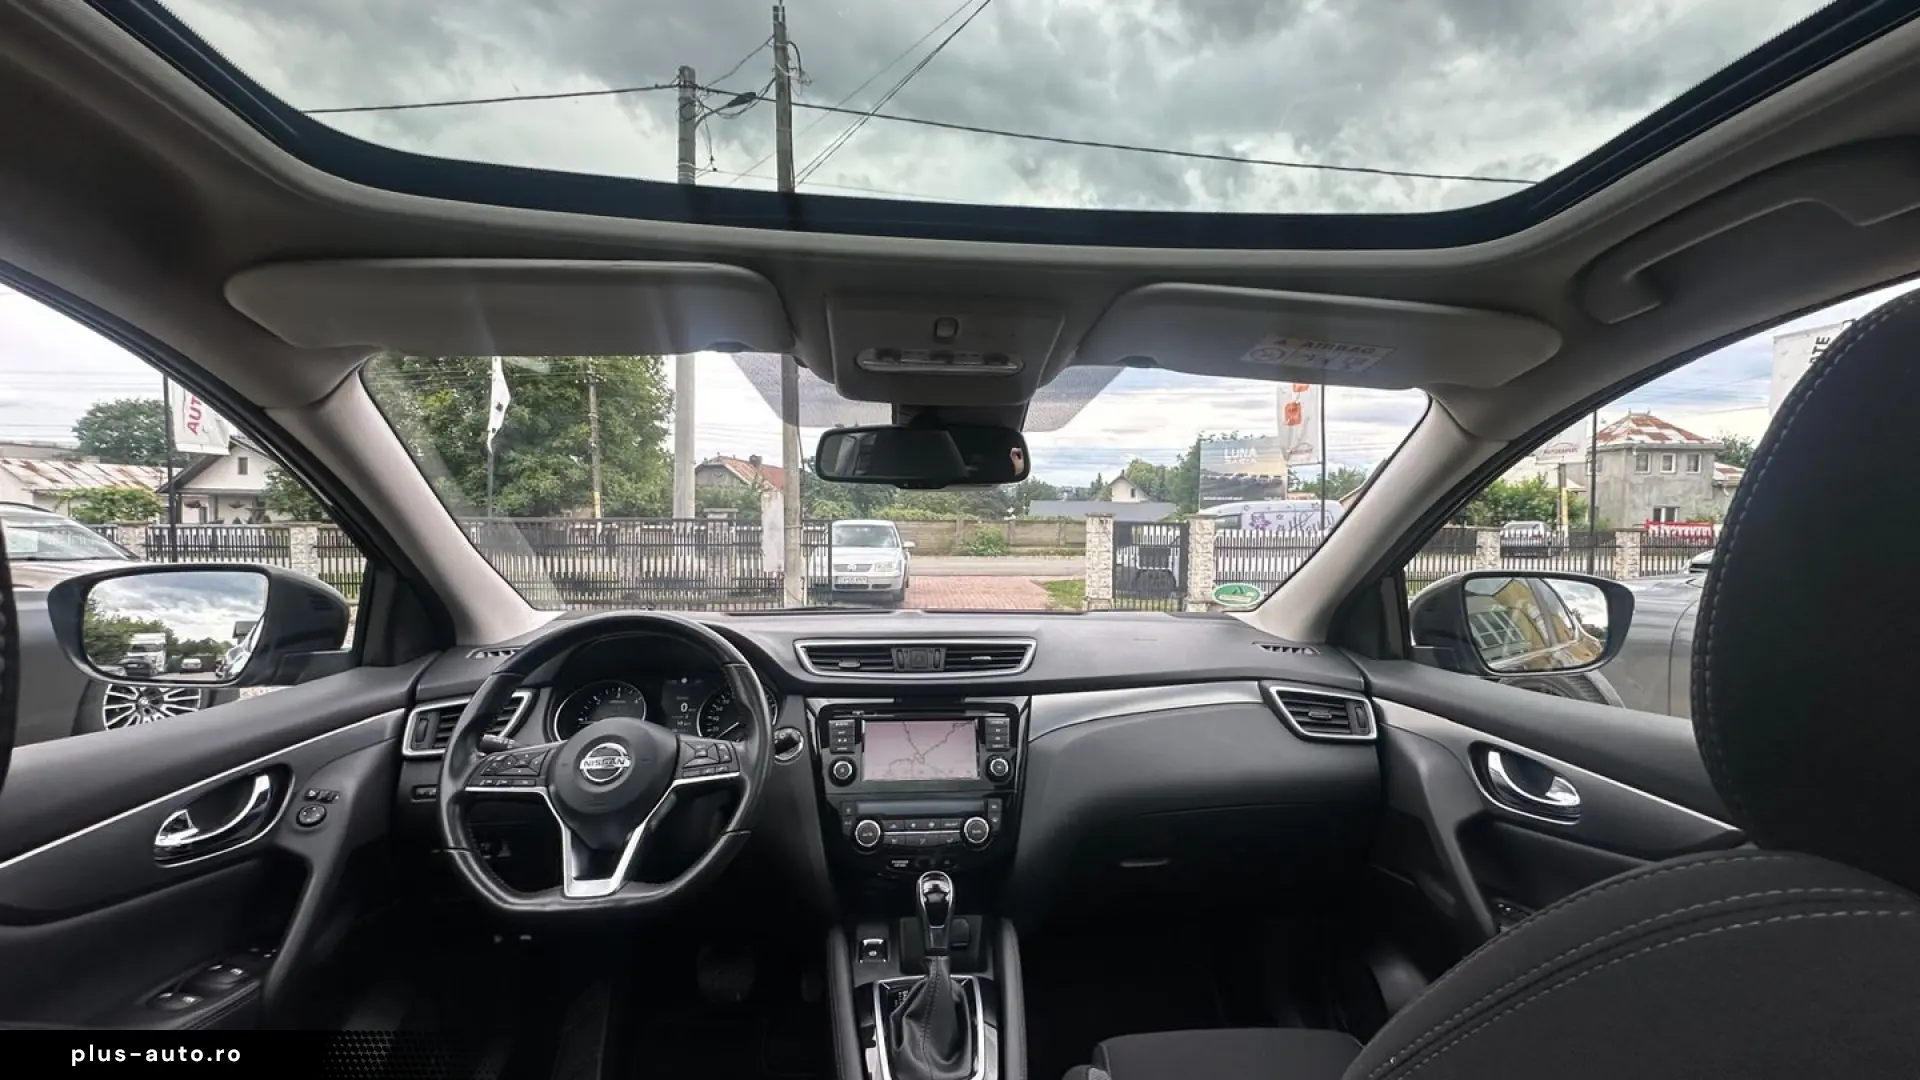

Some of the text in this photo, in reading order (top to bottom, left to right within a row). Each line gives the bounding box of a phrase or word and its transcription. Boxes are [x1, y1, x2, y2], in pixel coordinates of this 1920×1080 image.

[1300, 340, 1377, 355] AIRBAG
[1223, 446, 1258, 458] LUNA
[583, 758, 625, 767] NISSAN
